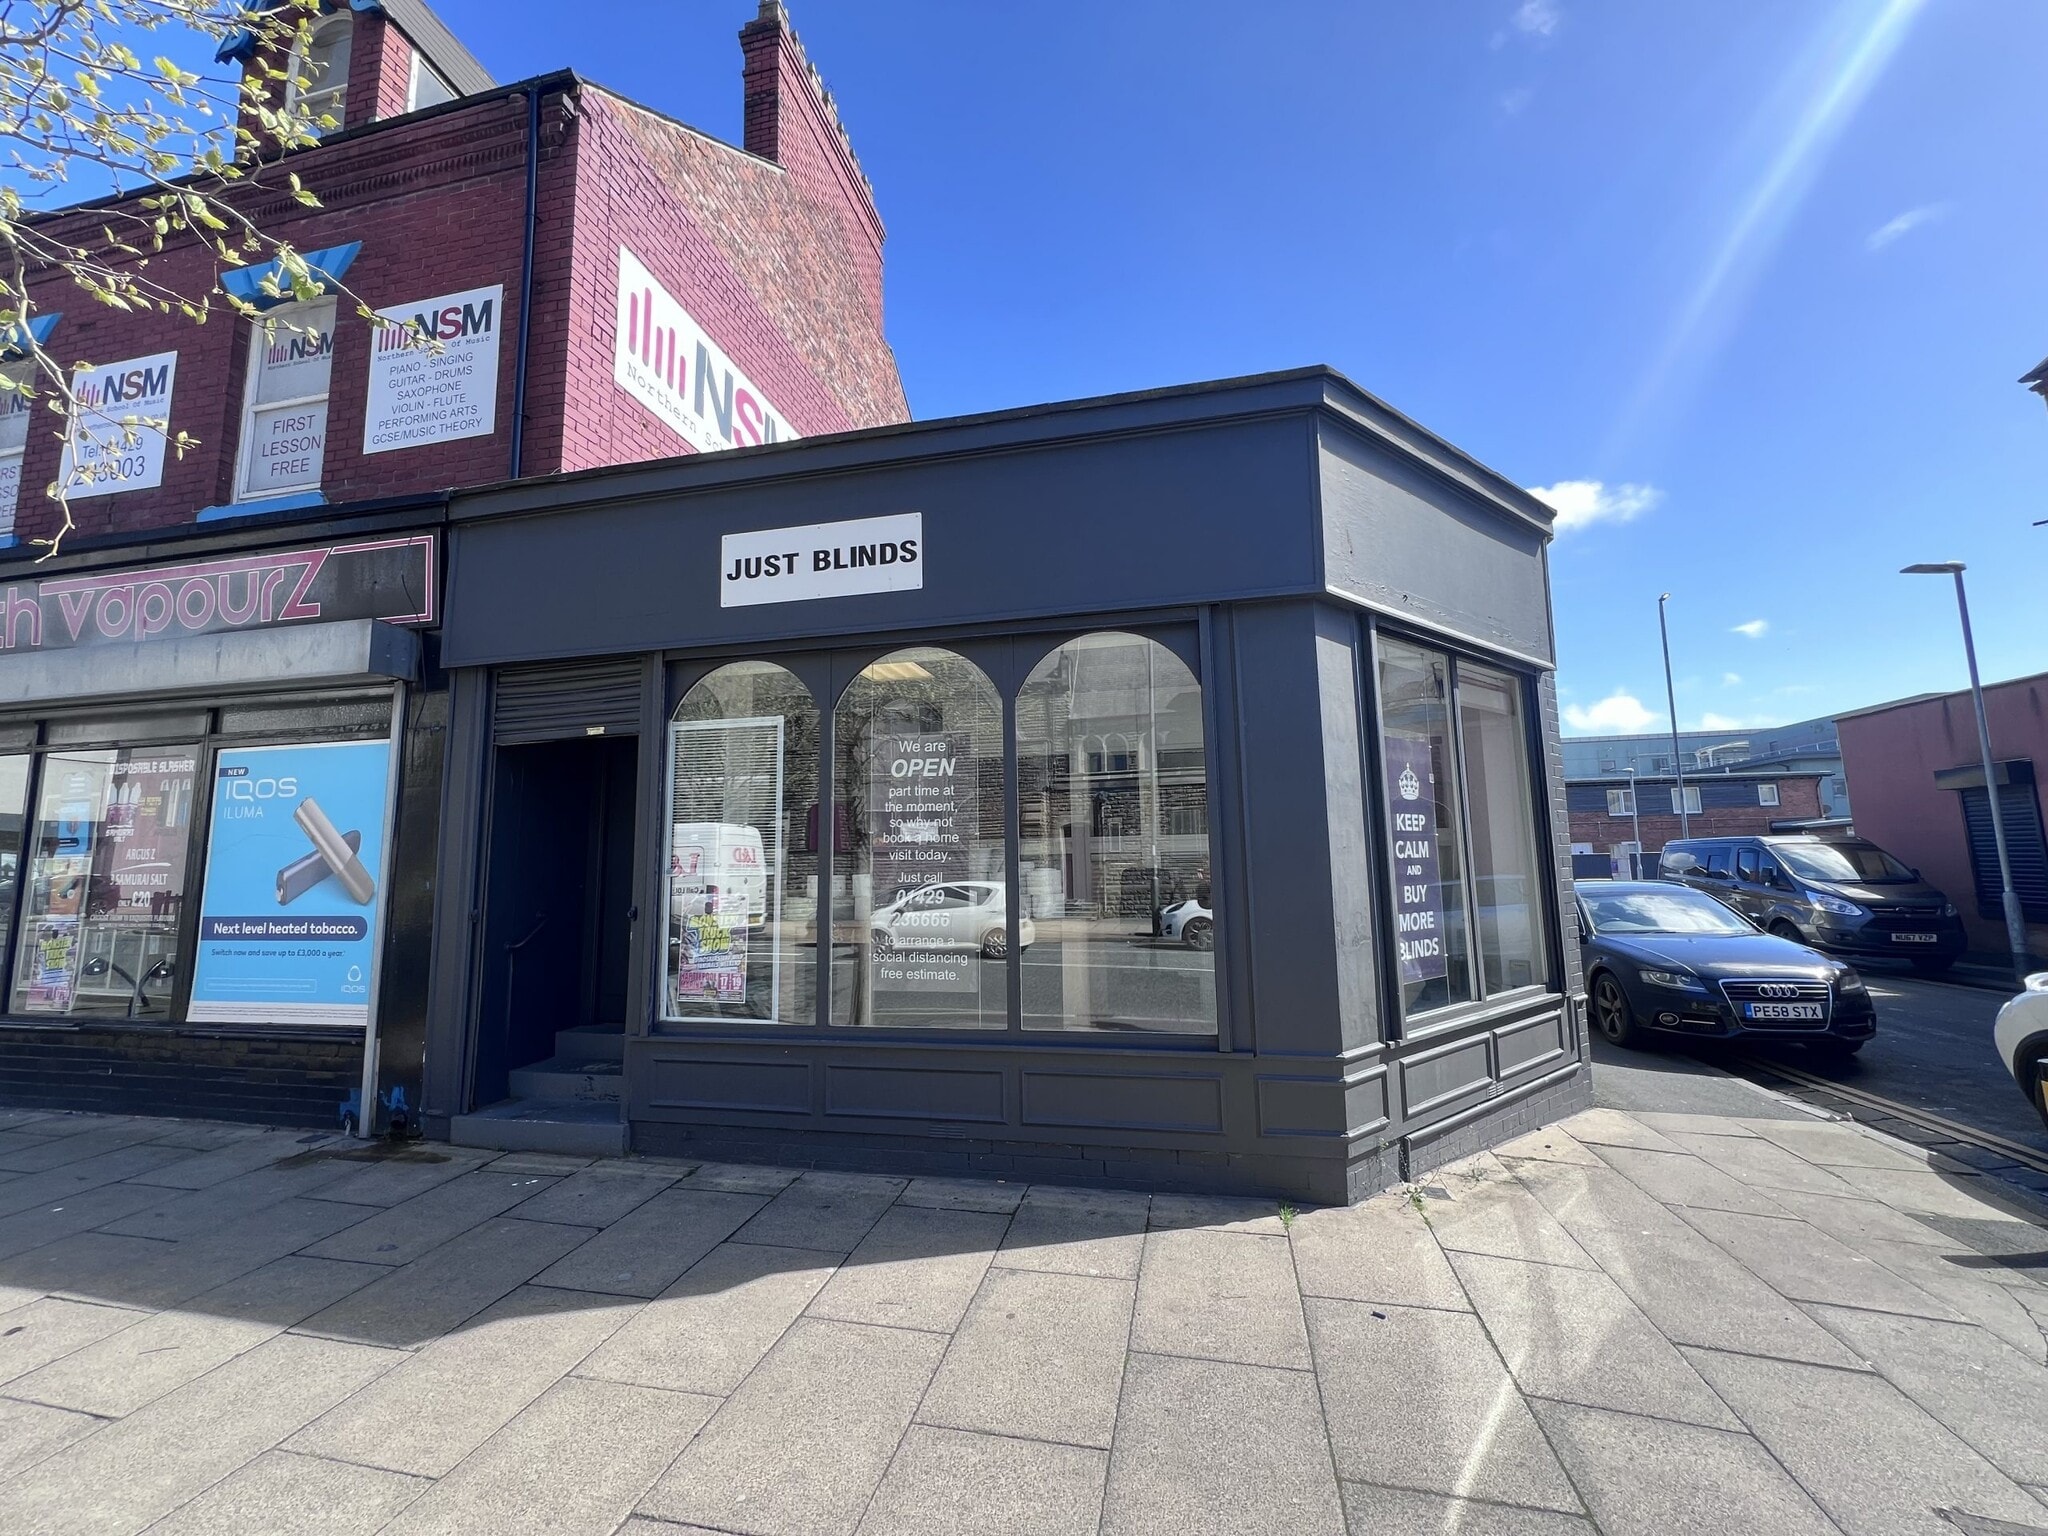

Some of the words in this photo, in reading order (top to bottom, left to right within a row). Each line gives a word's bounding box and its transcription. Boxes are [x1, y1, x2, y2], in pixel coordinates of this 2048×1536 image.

[414, 299, 493, 341] NSM
[377, 348, 414, 362] Northern
[465, 335, 491, 344] Music
[389, 362, 421, 375] PIANO
[429, 352, 474, 368] SINGING
[102, 365, 169, 405] NSM
[388, 374, 426, 389] GUITAR
[434, 366, 473, 382] DRUMS
[397, 380, 462, 400] SAXOPHONE
[627, 361, 697, 434] Northern
[392, 401, 424, 415] VIOLIN
[434, 393, 466, 407] FLUTE
[272, 415, 316, 435] FIRST
[378, 409, 447, 430] PERFORMING
[450, 405, 478, 418] ARTS
[372, 425, 437, 445] GCSE/MUSIC
[440, 418, 483, 434] THEORY
[262, 435, 322, 458] LESSON
[270, 458, 311, 477] FREE
[726, 552, 800, 581] JUST
[813, 539, 918, 572] BLINDS
[899, 740, 921, 753] We
[924, 742, 946, 752] are
[228, 768, 246, 776] NEW
[890, 757, 956, 778] OPEN
[226, 777, 297, 802] IQOS
[888, 786, 912, 799] part
[914, 784, 940, 796] time
[943, 785, 955, 796] at
[224, 806, 264, 819] ILUMA
[885, 801, 903, 812] the
[906, 801, 958, 813] moment,
[889, 818, 904, 828] so
[906, 816, 931, 830] why
[934, 816, 953, 827] not
[1396, 813, 1426, 832] KEEP
[883, 832, 911, 843] book
[914, 834, 921, 843] a
[925, 832, 960, 843] home
[126, 848, 148, 860] ARGUS
[149, 848, 156, 860] Z
[889, 849, 912, 861] visit
[915, 849, 952, 863] today.
[1395, 840, 1429, 859] CALM
[897, 871, 921, 883] Just
[923, 871, 943, 883] call
[1406, 865, 1422, 876] AND
[115, 874, 150, 886] SAMURAI
[150, 873, 168, 886] SALT
[131, 891, 151, 907] £20
[895, 889, 945, 905] 01429
[1403, 885, 1427, 904] BUY
[891, 912, 950, 927] 236666
[1399, 911, 1435, 933] MORE
[213, 922, 240, 934] Next
[242, 922, 267, 934] level
[268, 922, 307, 934] heated
[310, 923, 358, 935] tobacco.
[700, 927, 731, 939] TRUCK
[700, 939, 731, 952] SHOW
[885, 934, 896, 946] to
[899, 937, 944, 949] arrange
[947, 937, 955, 946] a
[1400, 937, 1439, 961] BLINDS
[278, 950, 287, 958] up
[297, 949, 321, 958] £3,000
[873, 951, 906, 962] social
[908, 951, 968, 966] distancing
[881, 967, 903, 979] free
[906, 968, 960, 980] estimate.
[341, 985, 366, 993] IQOS
[1753, 1005, 1790, 1018] PE58
[1793, 1006, 1820, 1018] STX
